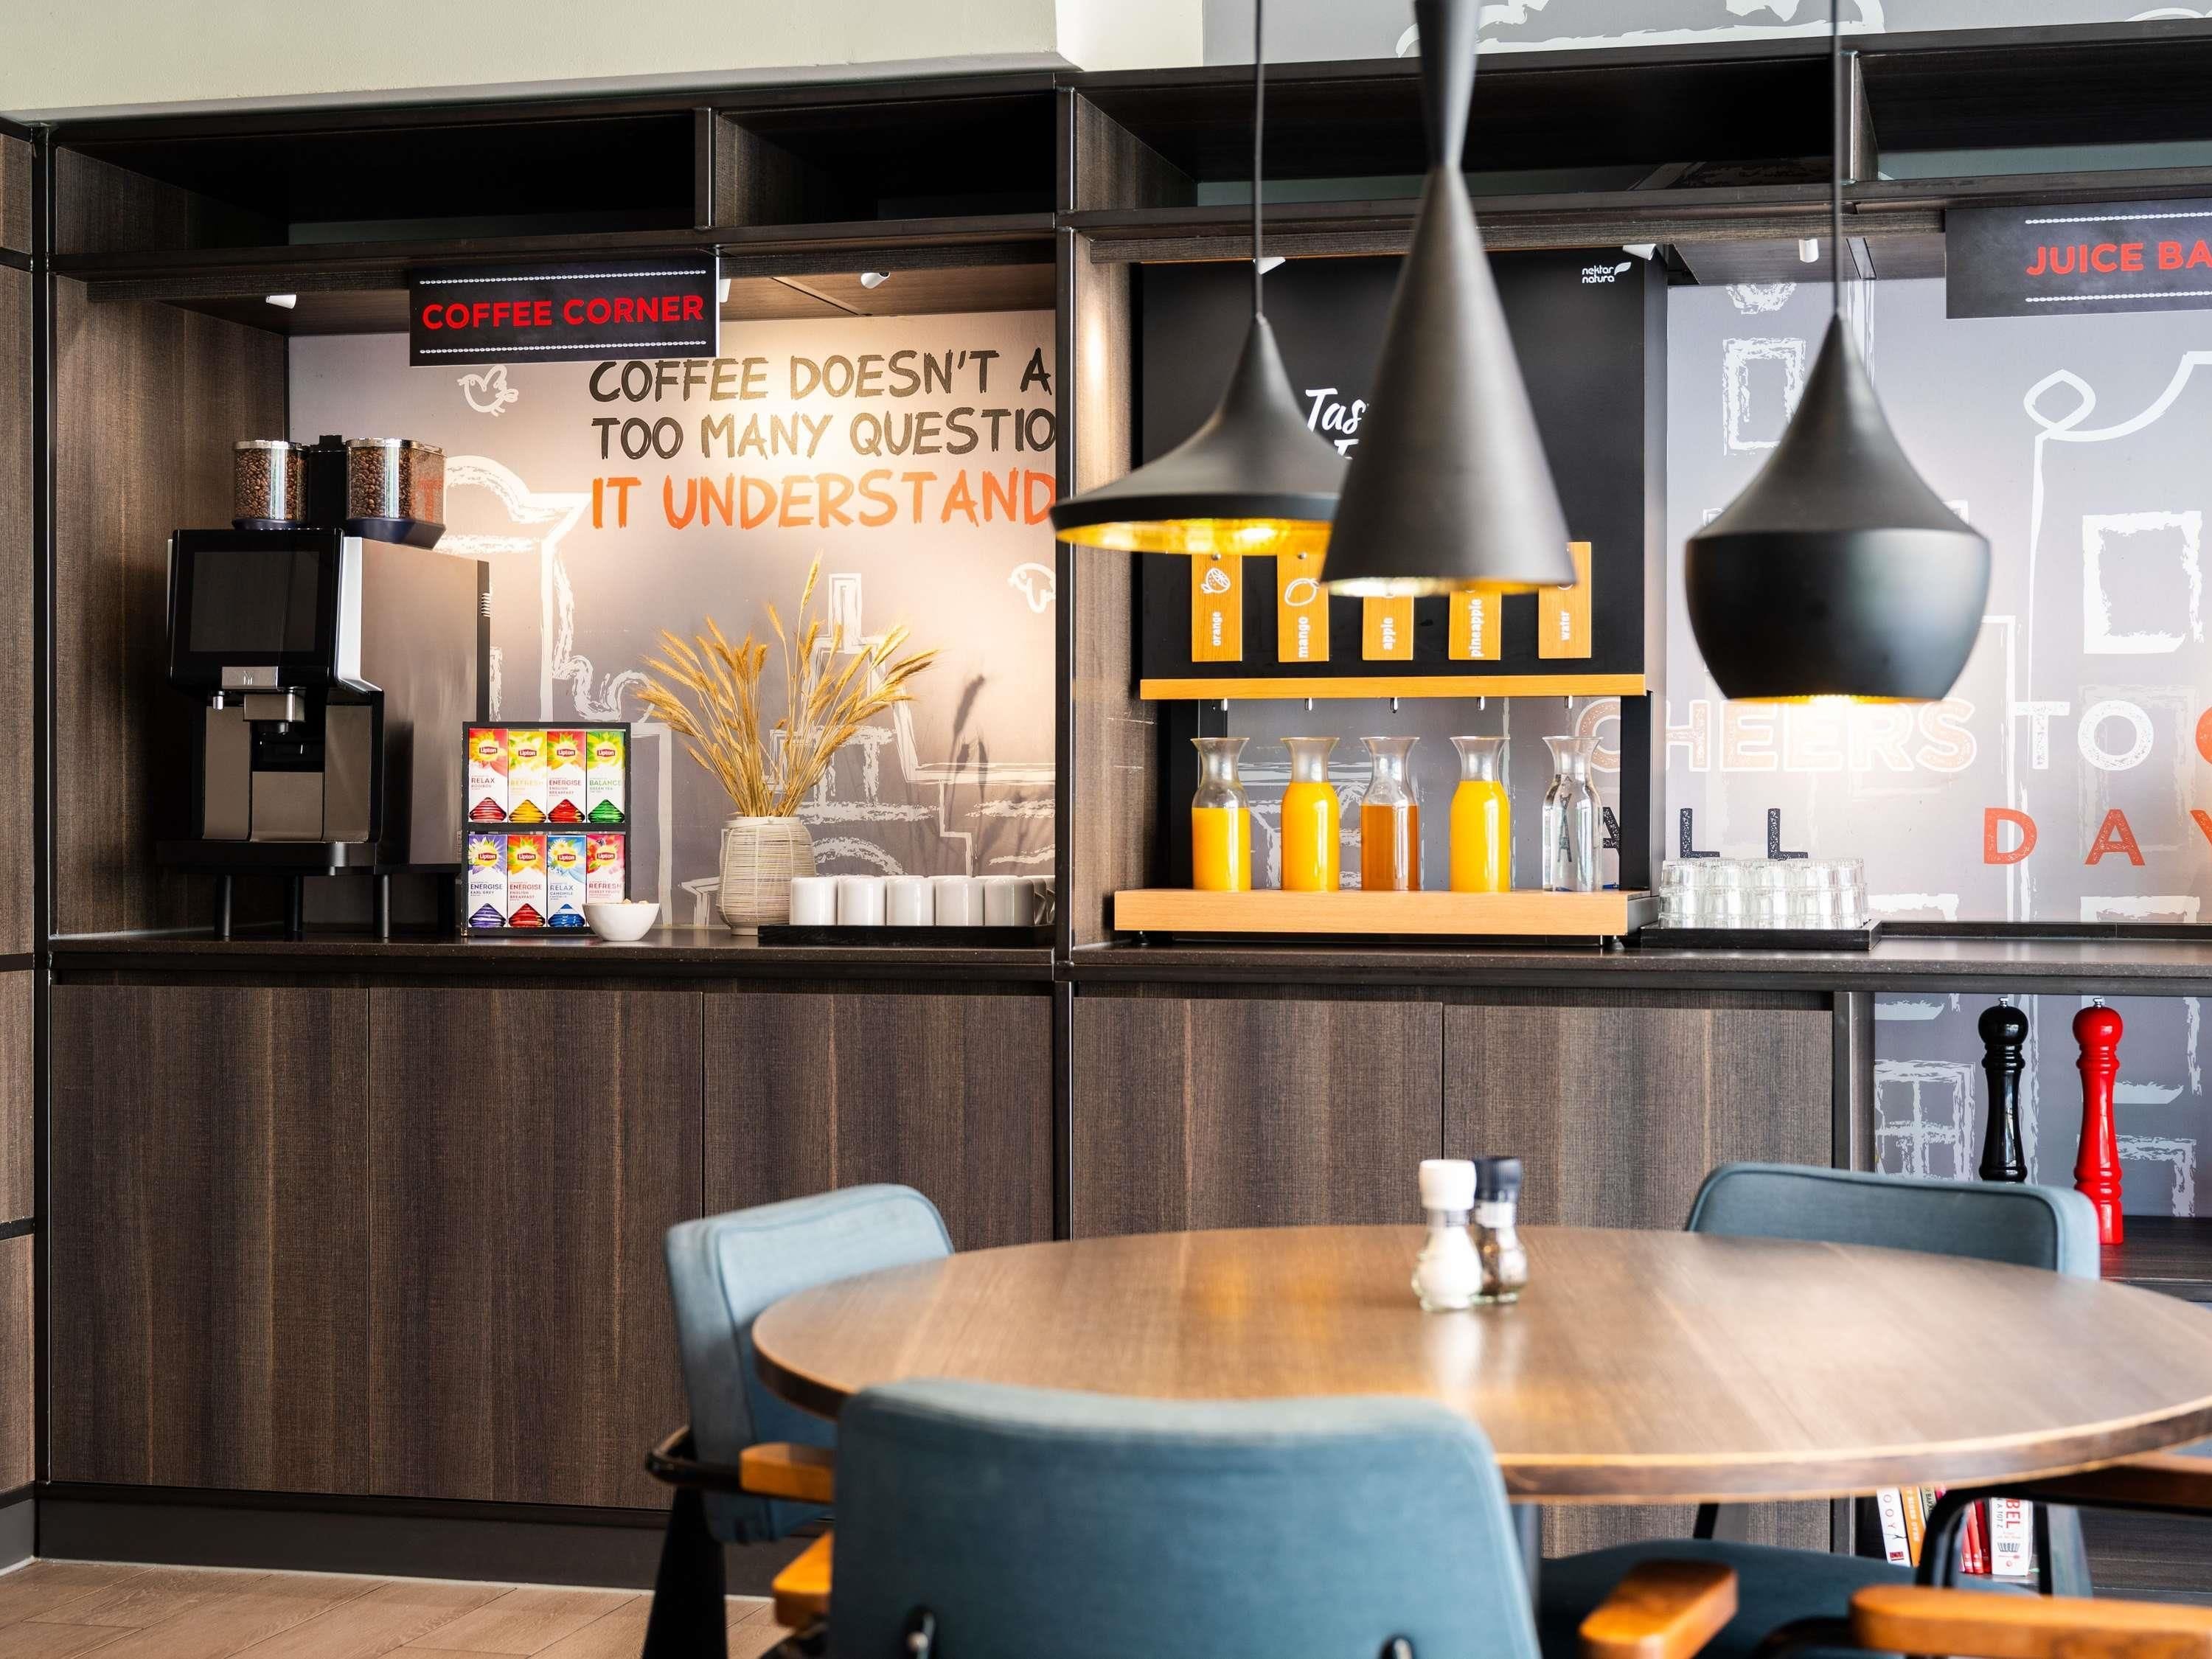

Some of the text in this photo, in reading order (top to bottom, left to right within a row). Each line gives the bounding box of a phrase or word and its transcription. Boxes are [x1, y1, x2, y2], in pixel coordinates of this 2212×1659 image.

[1582, 265, 1614, 275] nektar
[2025, 243, 2144, 276] JUICE
[1582, 274, 1615, 284] natura
[422, 295, 703, 330] COFFEE CORNER
[589, 347, 1053, 402] COFFEE DOESN'T A
[1305, 388, 1367, 434] Tas
[591, 407, 1056, 460] TOO MANY QUESTIO
[592, 467, 1056, 530] IT UNDERSTAND
[1211, 611, 1223, 647] orange
[1298, 616, 1311, 658] mango
[1380, 616, 1397, 651] apple
[1468, 598, 1485, 658] pineapple
[1559, 611, 1571, 641] water
[2011, 700, 2154, 771] TO
[2006, 1498, 2021, 1528] BEL
